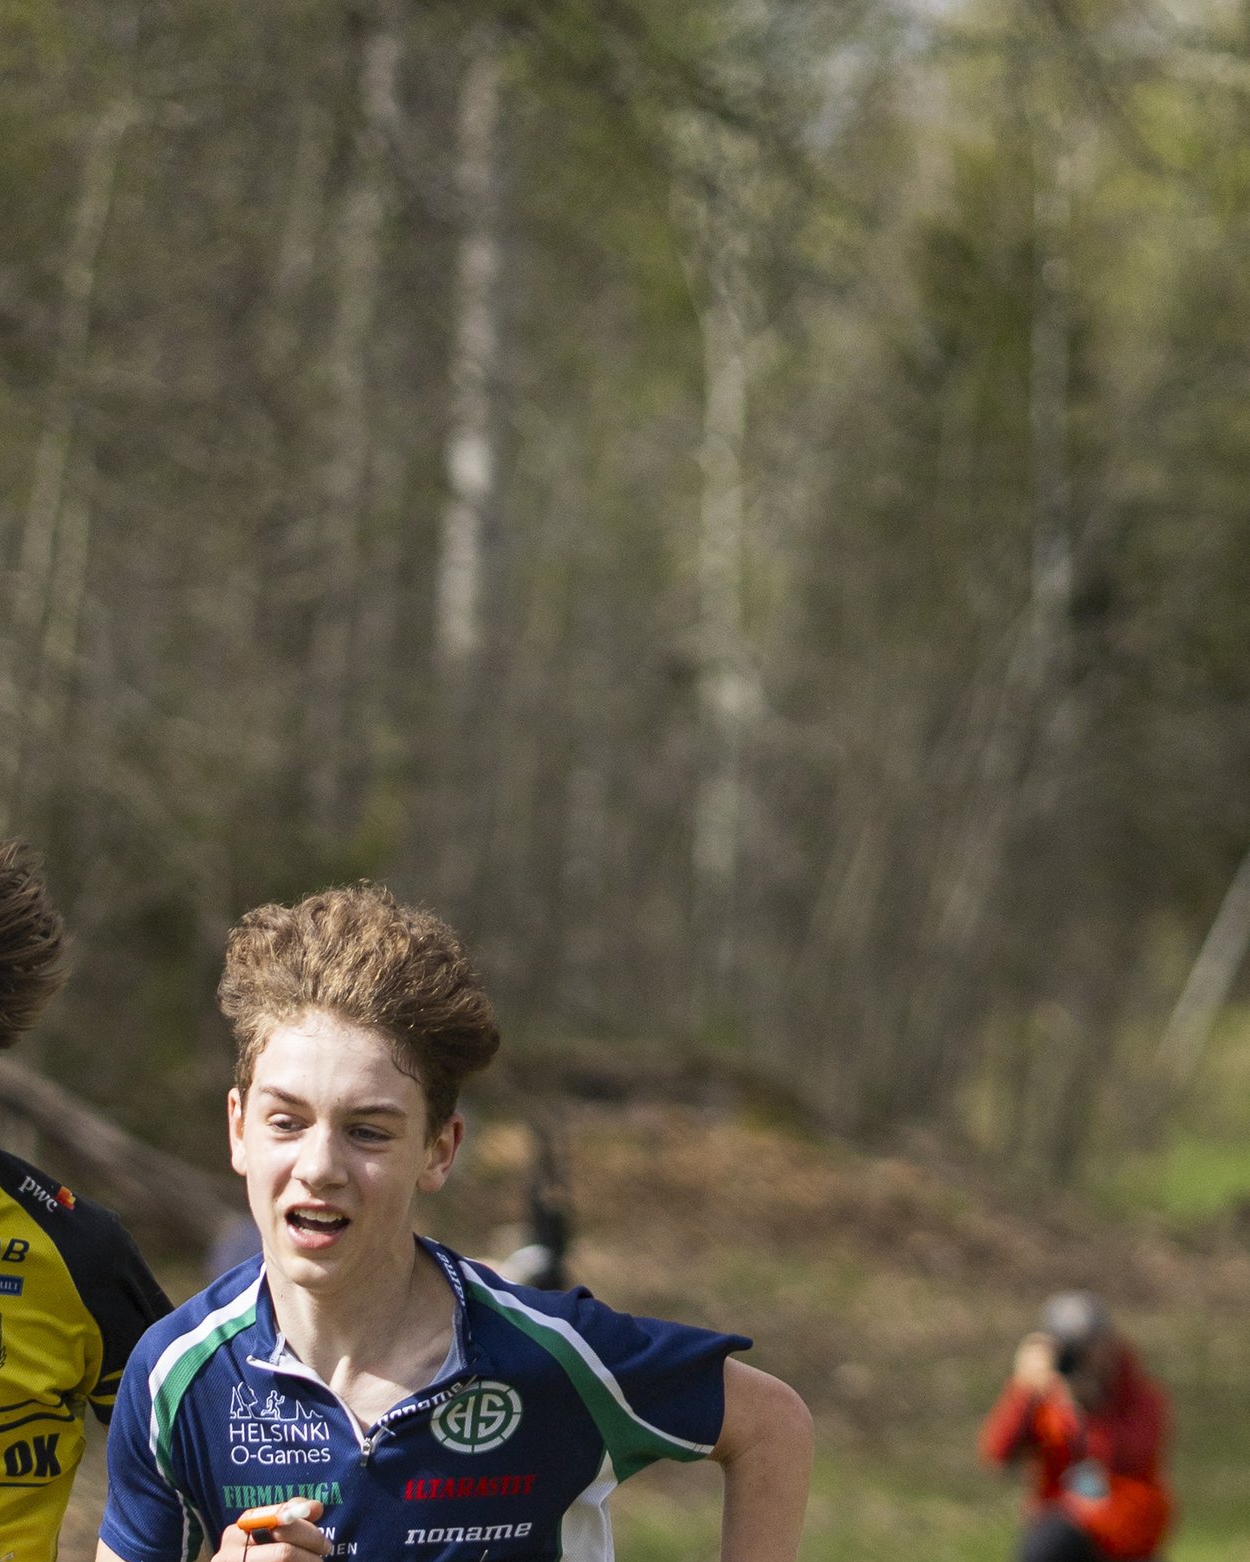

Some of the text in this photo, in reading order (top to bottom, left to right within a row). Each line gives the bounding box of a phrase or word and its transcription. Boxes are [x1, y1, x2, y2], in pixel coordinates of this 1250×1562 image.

[18, 1175, 58, 1213] pwc
[229, 1421, 330, 1442] HELSINKI
[4, 1434, 62, 1478] OK
[231, 1445, 331, 1465] O-Games
[405, 1522, 533, 1545] noname
